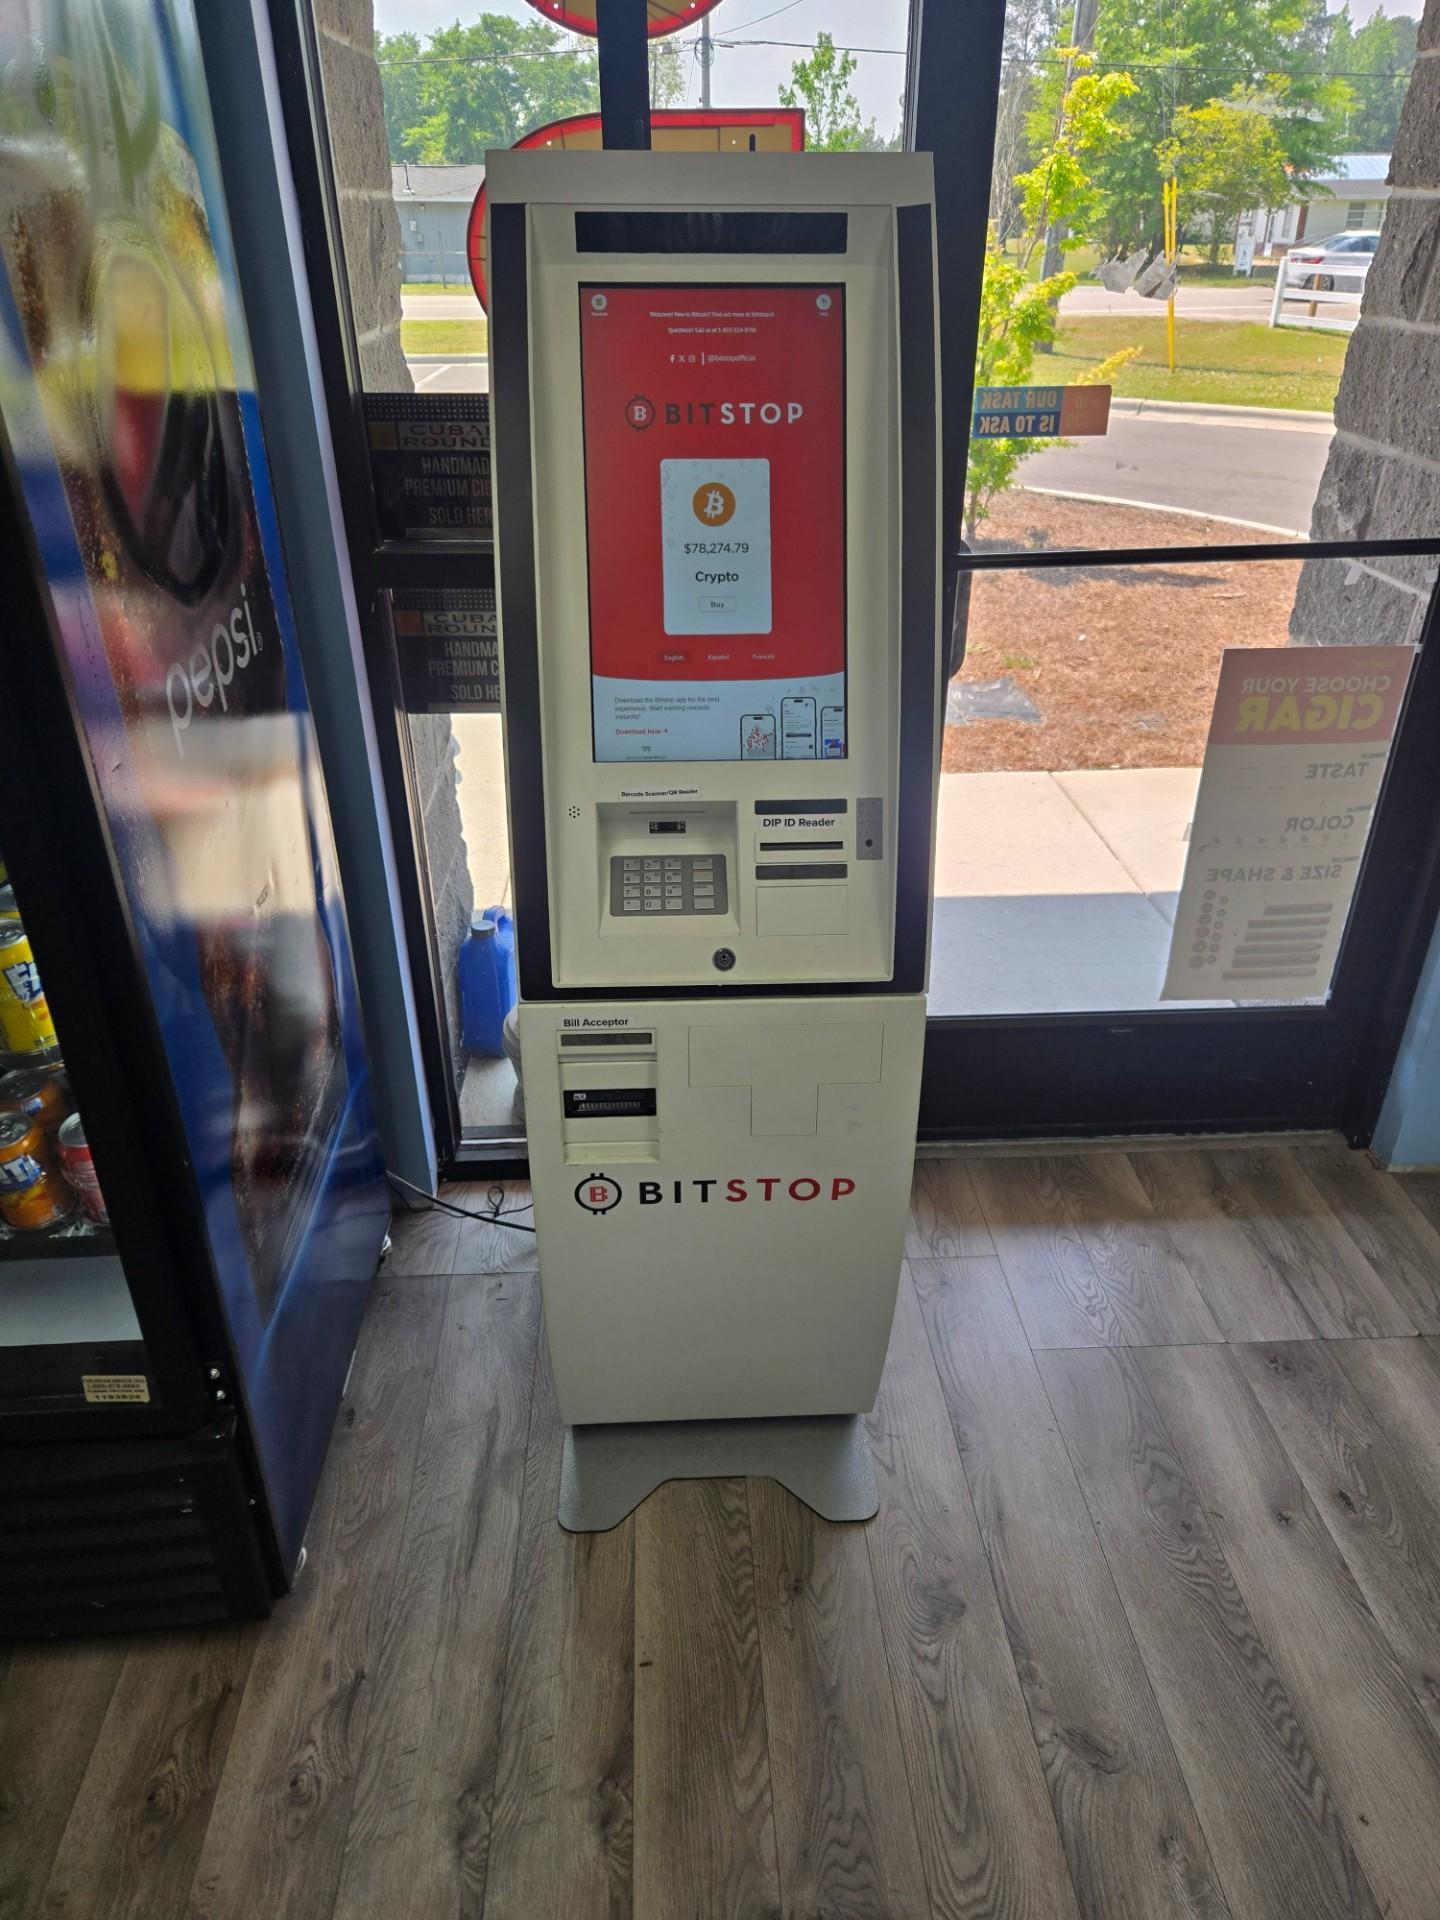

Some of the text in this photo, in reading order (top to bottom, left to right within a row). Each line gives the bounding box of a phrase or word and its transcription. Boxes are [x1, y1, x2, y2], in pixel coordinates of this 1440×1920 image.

[665, 402, 804, 425] BITSTOP
[409, 424, 490, 436] CUBA
[404, 478, 469, 497] PREMIUM
[429, 506, 464, 525] SOLD
[683, 541, 750, 556] $78,274.79
[695, 571, 739, 584] Crypto
[710, 601, 725, 609] Buy
[166, 581, 259, 761] pepsi
[427, 660, 489, 677] PREMIUM
[450, 684, 483, 700] SOLD
[614, 696, 643, 704] Download
[762, 817, 837, 828] DIP ID Reader
[563, 1017, 630, 1028] Bill Acceptor
[638, 1177, 857, 1205] BITSTOP
